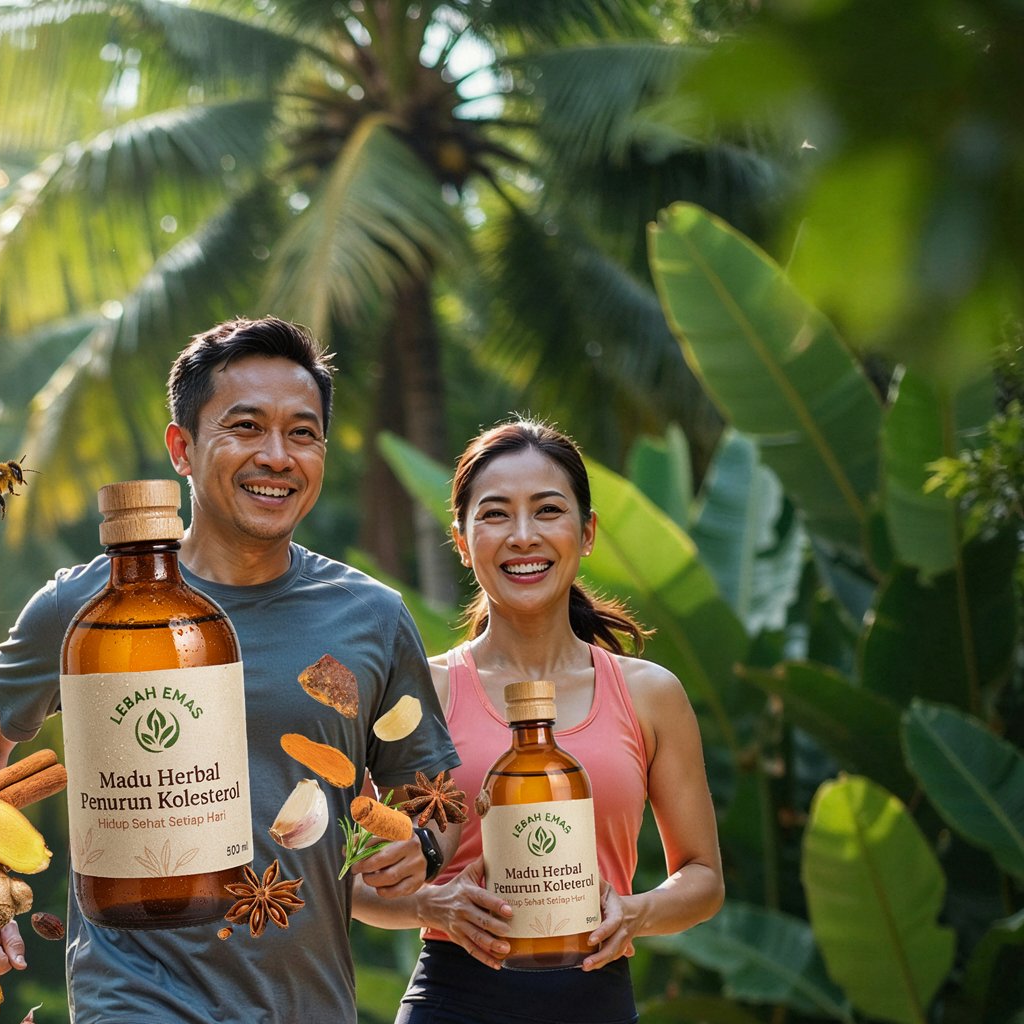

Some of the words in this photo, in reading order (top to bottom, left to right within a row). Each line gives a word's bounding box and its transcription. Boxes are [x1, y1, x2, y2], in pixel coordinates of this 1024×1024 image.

[110, 686, 157, 725] LEBAH
[162, 686, 204, 719] EMAS
[98, 769, 152, 789] Madu
[158, 762, 221, 787] Herbal
[80, 792, 152, 811] Penurun
[157, 781, 241, 809] Kolesterol
[98, 818, 129, 831] Hidup
[132, 817, 166, 829] Sehat
[169, 814, 205, 828] Setiap
[207, 810, 227, 823] Hari
[226, 844, 241, 857] 500
[505, 866, 539, 880] Madu
[543, 863, 582, 878] Herbal
[494, 882, 541, 894] Penurun
